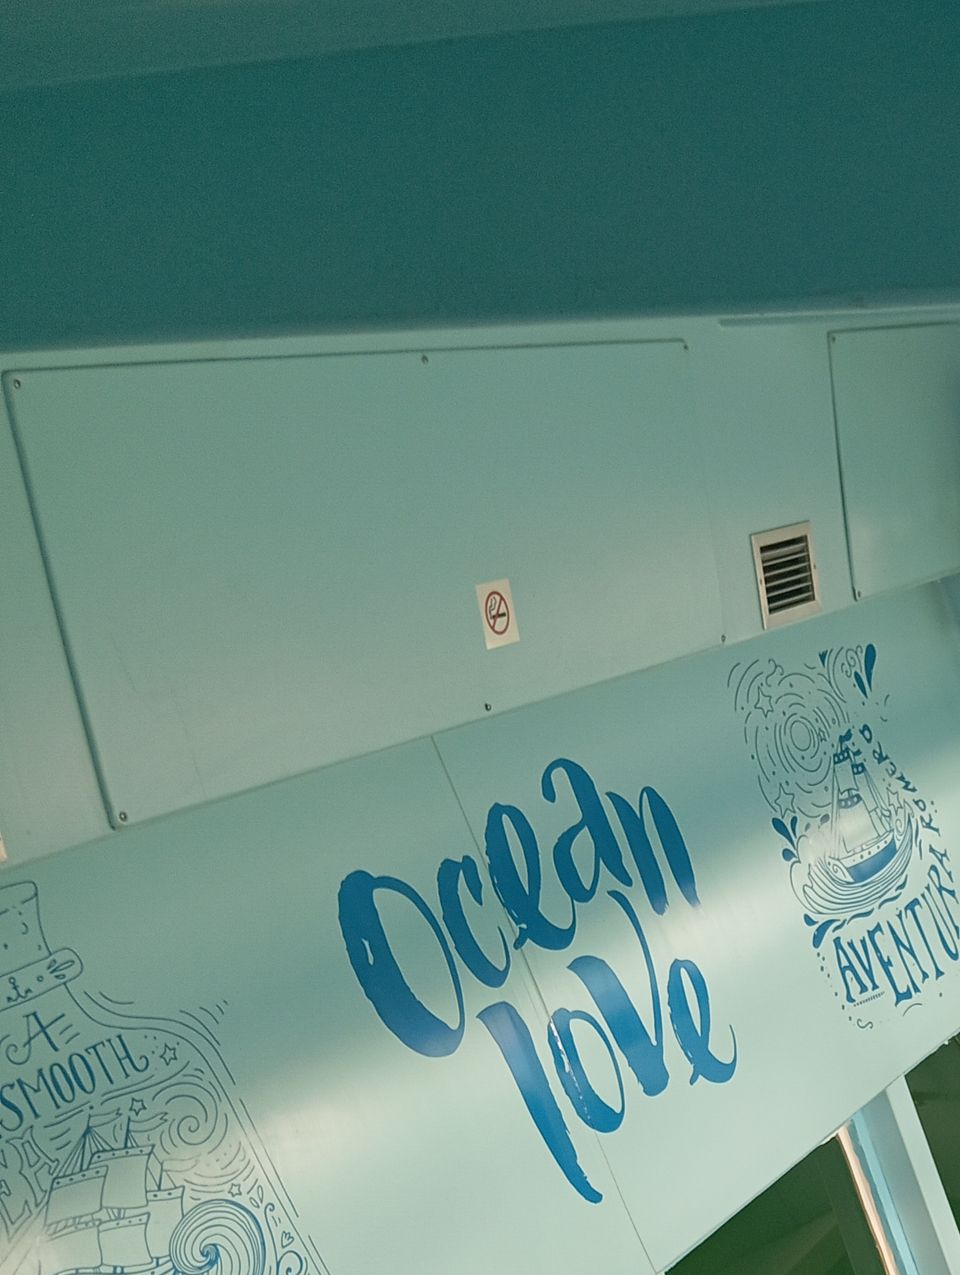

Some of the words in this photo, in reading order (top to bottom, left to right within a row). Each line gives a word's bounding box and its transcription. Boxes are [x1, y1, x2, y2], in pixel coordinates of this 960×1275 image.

[338, 758, 701, 1058] Ocean
[832, 844, 960, 1007] AVENTURA
[0, 1033, 150, 1133] SMOOTH
[6, 1010, 66, 1066] A
